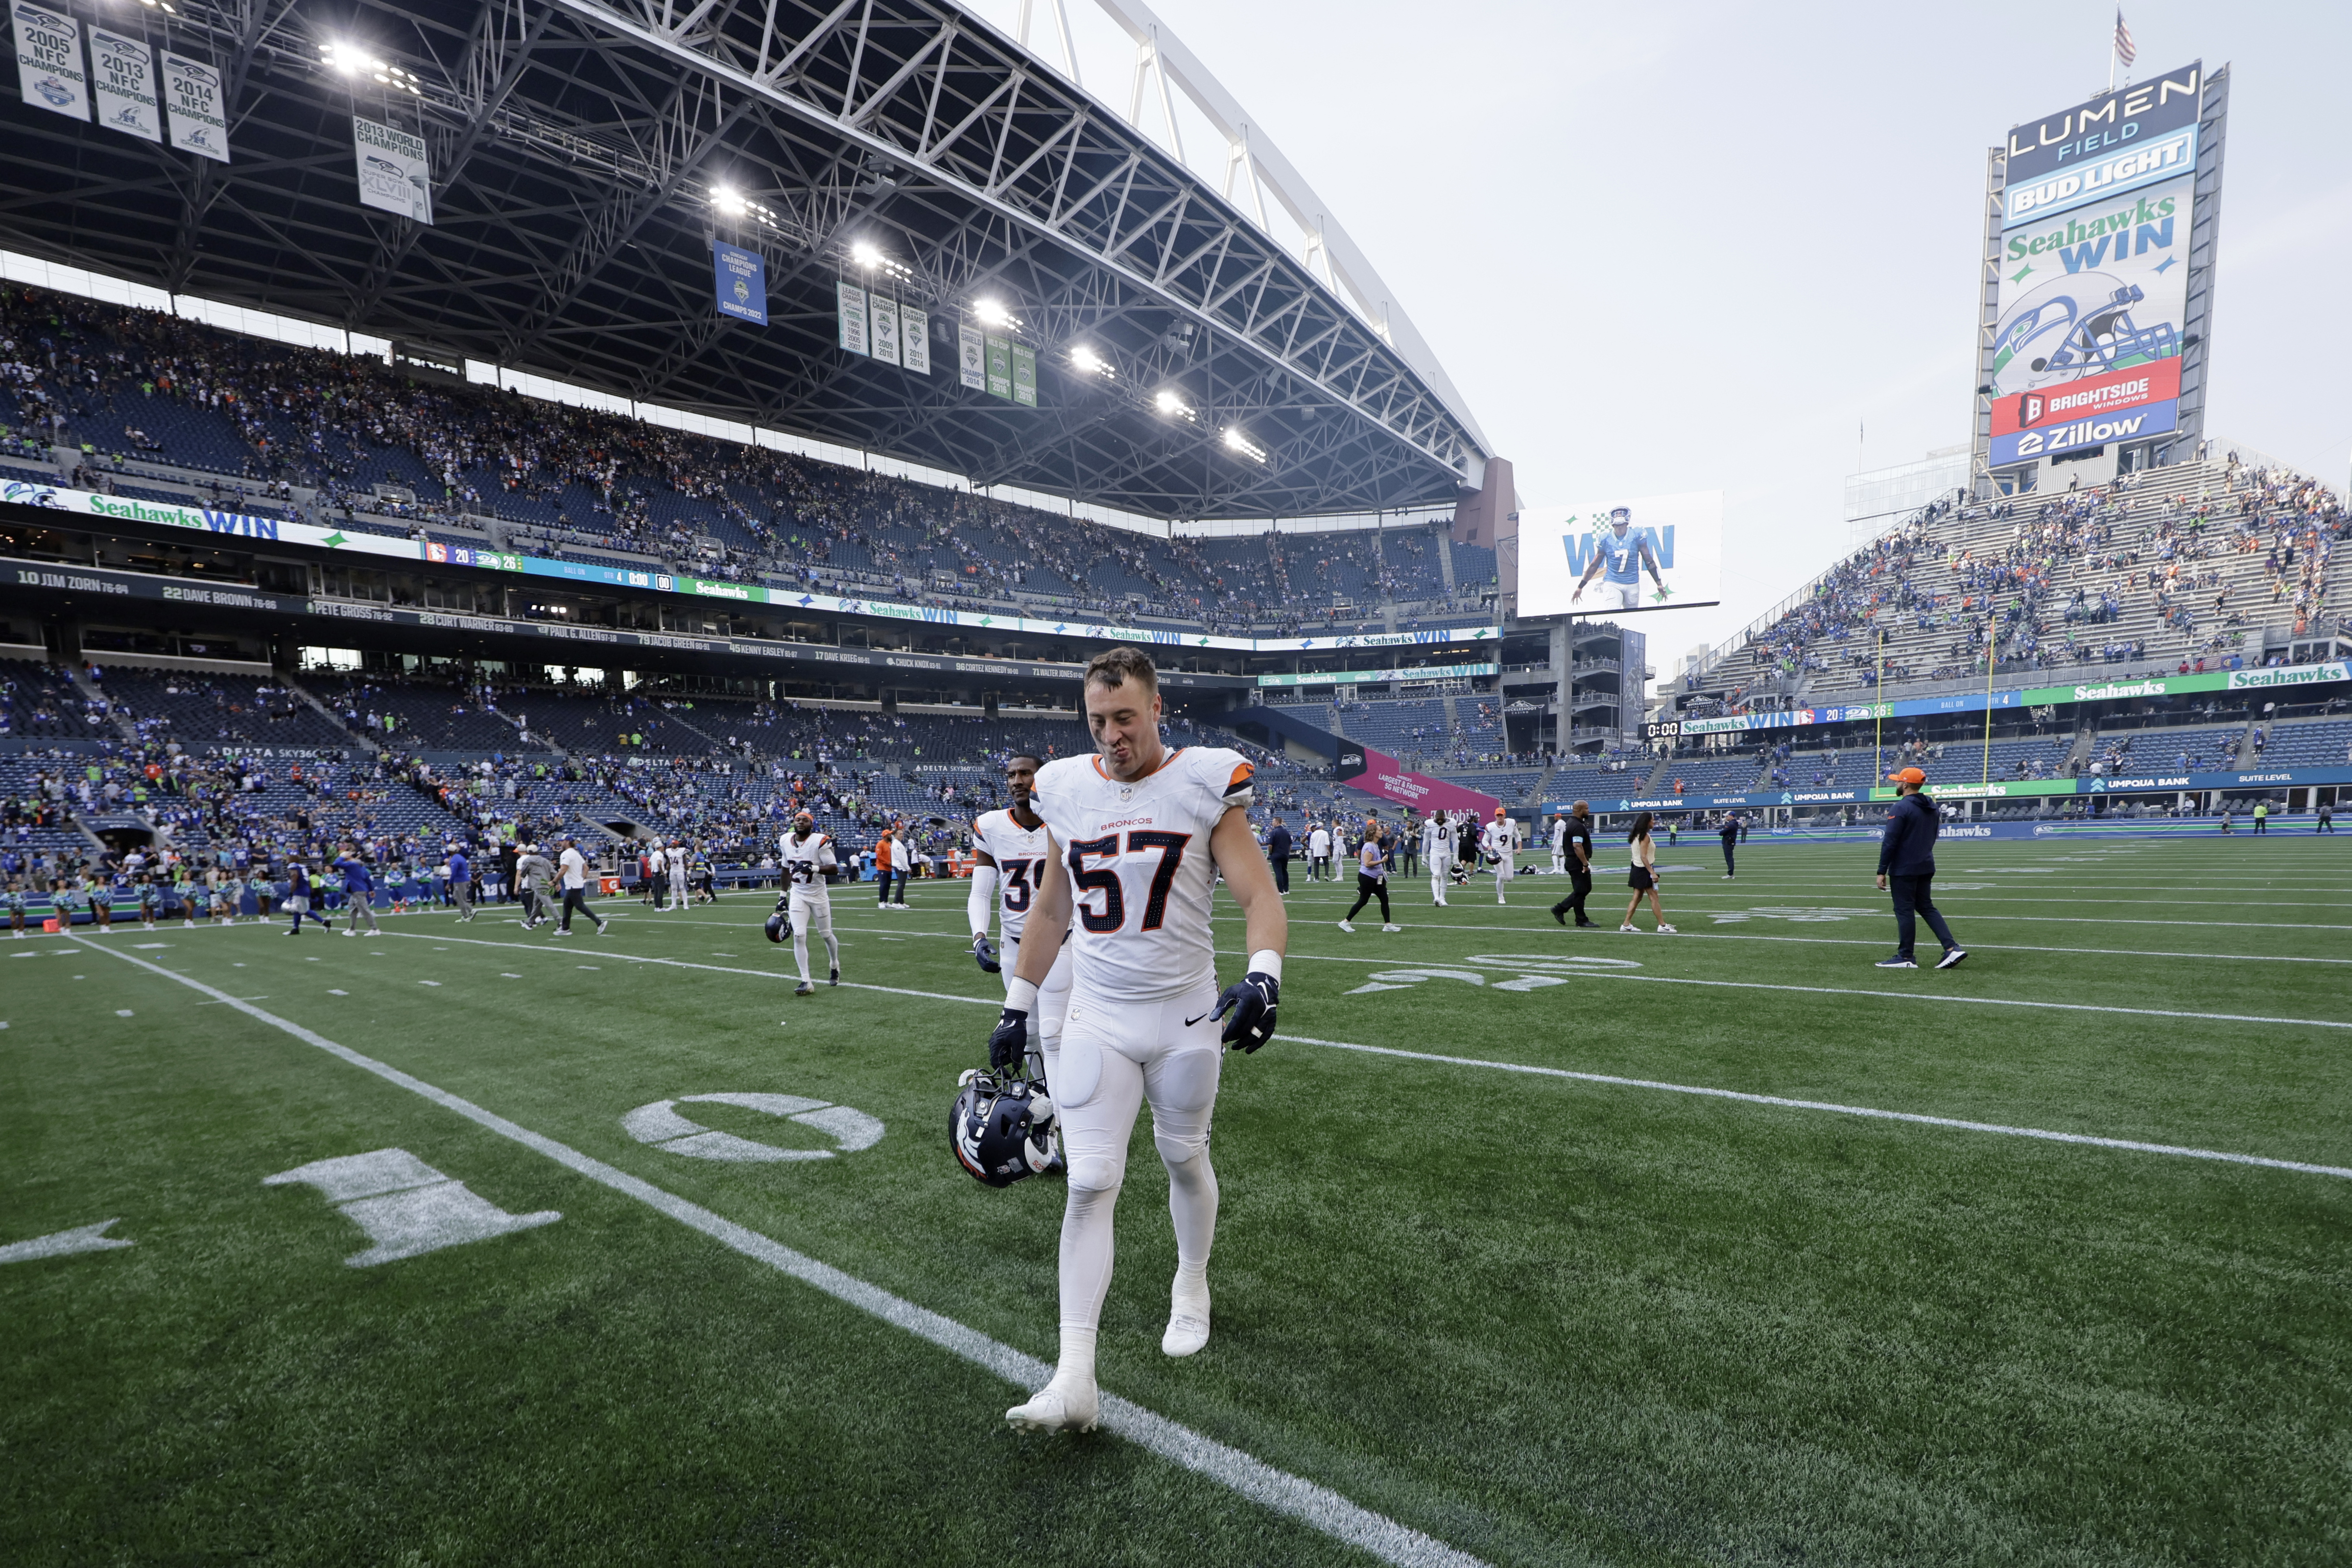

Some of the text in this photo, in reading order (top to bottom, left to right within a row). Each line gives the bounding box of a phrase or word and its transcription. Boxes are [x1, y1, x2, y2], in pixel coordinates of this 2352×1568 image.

[25, 27, 70, 53] 2005
[34, 45, 66, 66] NFC
[19, 54, 83, 82] CHAMPIONS
[101, 53, 144, 79] 2013
[110, 71, 140, 91] NFC
[96, 80, 156, 106] CHAMPIONS
[173, 77, 214, 101] 2014
[181, 95, 209, 113] NFC
[168, 103, 224, 128] CHAMPIONS
[2010, 70, 2197, 157] LUMEN
[356, 120, 422, 150] 2013 WORLD
[2058, 122, 2139, 162] FIELD
[357, 131, 423, 161] CHAMPIONS
[362, 169, 406, 186] SUPER BOWL
[2015, 140, 2184, 213] BUD LIGHT
[361, 174, 410, 199] XLVIII
[367, 189, 405, 203] CHAMPIONS
[2007, 196, 2175, 262] Seahawks
[2059, 216, 2174, 274] WIN
[722, 254, 757, 271] CHAMPIONS
[729, 264, 751, 277] LEAGUE
[842, 293, 862, 304] CHAMPS
[843, 286, 861, 298] LEAGUE
[723, 301, 761, 319] CHAMPS 2022
[873, 302, 895, 314] CHAMPS
[847, 320, 859, 329] 1995
[903, 312, 925, 325] CHAMPS
[848, 327, 860, 336] 1996
[848, 334, 860, 343] 2005
[848, 342, 860, 351] 2007
[879, 339, 893, 350] 2009
[961, 333, 981, 346] SHIELD
[988, 338, 1009, 350] MLS CUP
[879, 348, 893, 358] 2010
[910, 349, 923, 359] 2011
[1014, 347, 1034, 359] MLS CUP
[910, 358, 924, 368] 2014
[961, 367, 984, 380] CHAMPS
[989, 374, 1010, 387] CHAMPS
[967, 377, 979, 385] 2014
[993, 382, 1006, 394] 2016
[1016, 382, 1035, 395] CHAMPS
[2050, 378, 2149, 412] BRIGHTSIDE
[1019, 391, 1032, 402] 2019
[2093, 393, 2148, 409] WINDOWS
[2028, 399, 2041, 422] B
[2048, 416, 2143, 450] Zillow
[90, 495, 278, 540] Seahawks WIN
[455, 548, 469, 563] 20
[1563, 525, 1675, 577] WN
[503, 555, 516, 569] 26
[1615, 549, 1629, 572] 7
[18, 570, 39, 584] 10
[41, 573, 65, 588] JIM
[67, 576, 101, 592] ZORN
[617, 572, 622, 582] 4
[629, 572, 648, 586] 0:00
[659, 577, 669, 589] 00
[163, 587, 182, 599] 22
[183, 589, 211, 603] DAVE
[213, 592, 252, 607] BROWN
[696, 581, 748, 599] Seahawks
[315, 603, 339, 616] PETE
[340, 606, 372, 619] GROSS
[870, 602, 957, 624] Seahawks WIN
[420, 614, 435, 624] 28
[436, 616, 458, 627] CURT
[459, 618, 494, 631] WARNER
[550, 627, 569, 638] PAUL
[570, 629, 577, 639] G.
[579, 630, 600, 641] ALLEN
[1110, 628, 1180, 644] Seahawks WIN
[1364, 630, 1450, 645] Seahawks WIN
[638, 636, 650, 644] 79
[650, 638, 671, 646] JACOB
[673, 639, 694, 649] GREEN
[730, 643, 740, 652] 45
[741, 645, 761, 655] KENNY
[762, 647, 784, 657] EASLEY
[815, 651, 824, 660] 17
[825, 652, 838, 661] DAVE
[840, 654, 857, 663] KRIEG
[896, 658, 928, 668] CHUCK KNOX
[1402, 664, 1488, 679] Seahawks WIN
[2234, 666, 2341, 687] Seahawks
[1296, 675, 1336, 683] Seahawks
[2074, 681, 2165, 701] Seahawks
[2002, 695, 2009, 705] 4
[1826, 710, 1838, 721] 20
[1874, 704, 1886, 716] 26
[1648, 723, 1678, 737] 0:00
[1684, 712, 1794, 734] Seahawks WIN
[1378, 774, 1401, 786] LARGEST
[1406, 783, 1429, 795] FASTEST
[2108, 777, 2189, 787] UMPQUA BANK
[1392, 786, 1419, 799] NETWORK
[1931, 785, 2006, 799] Seahawks
[1101, 818, 1152, 831] BRONCOS
[1438, 827, 1447, 840] 0
[1500, 834, 1507, 846] 9
[609, 880, 617, 889] G
[1069, 830, 1192, 934] 57
